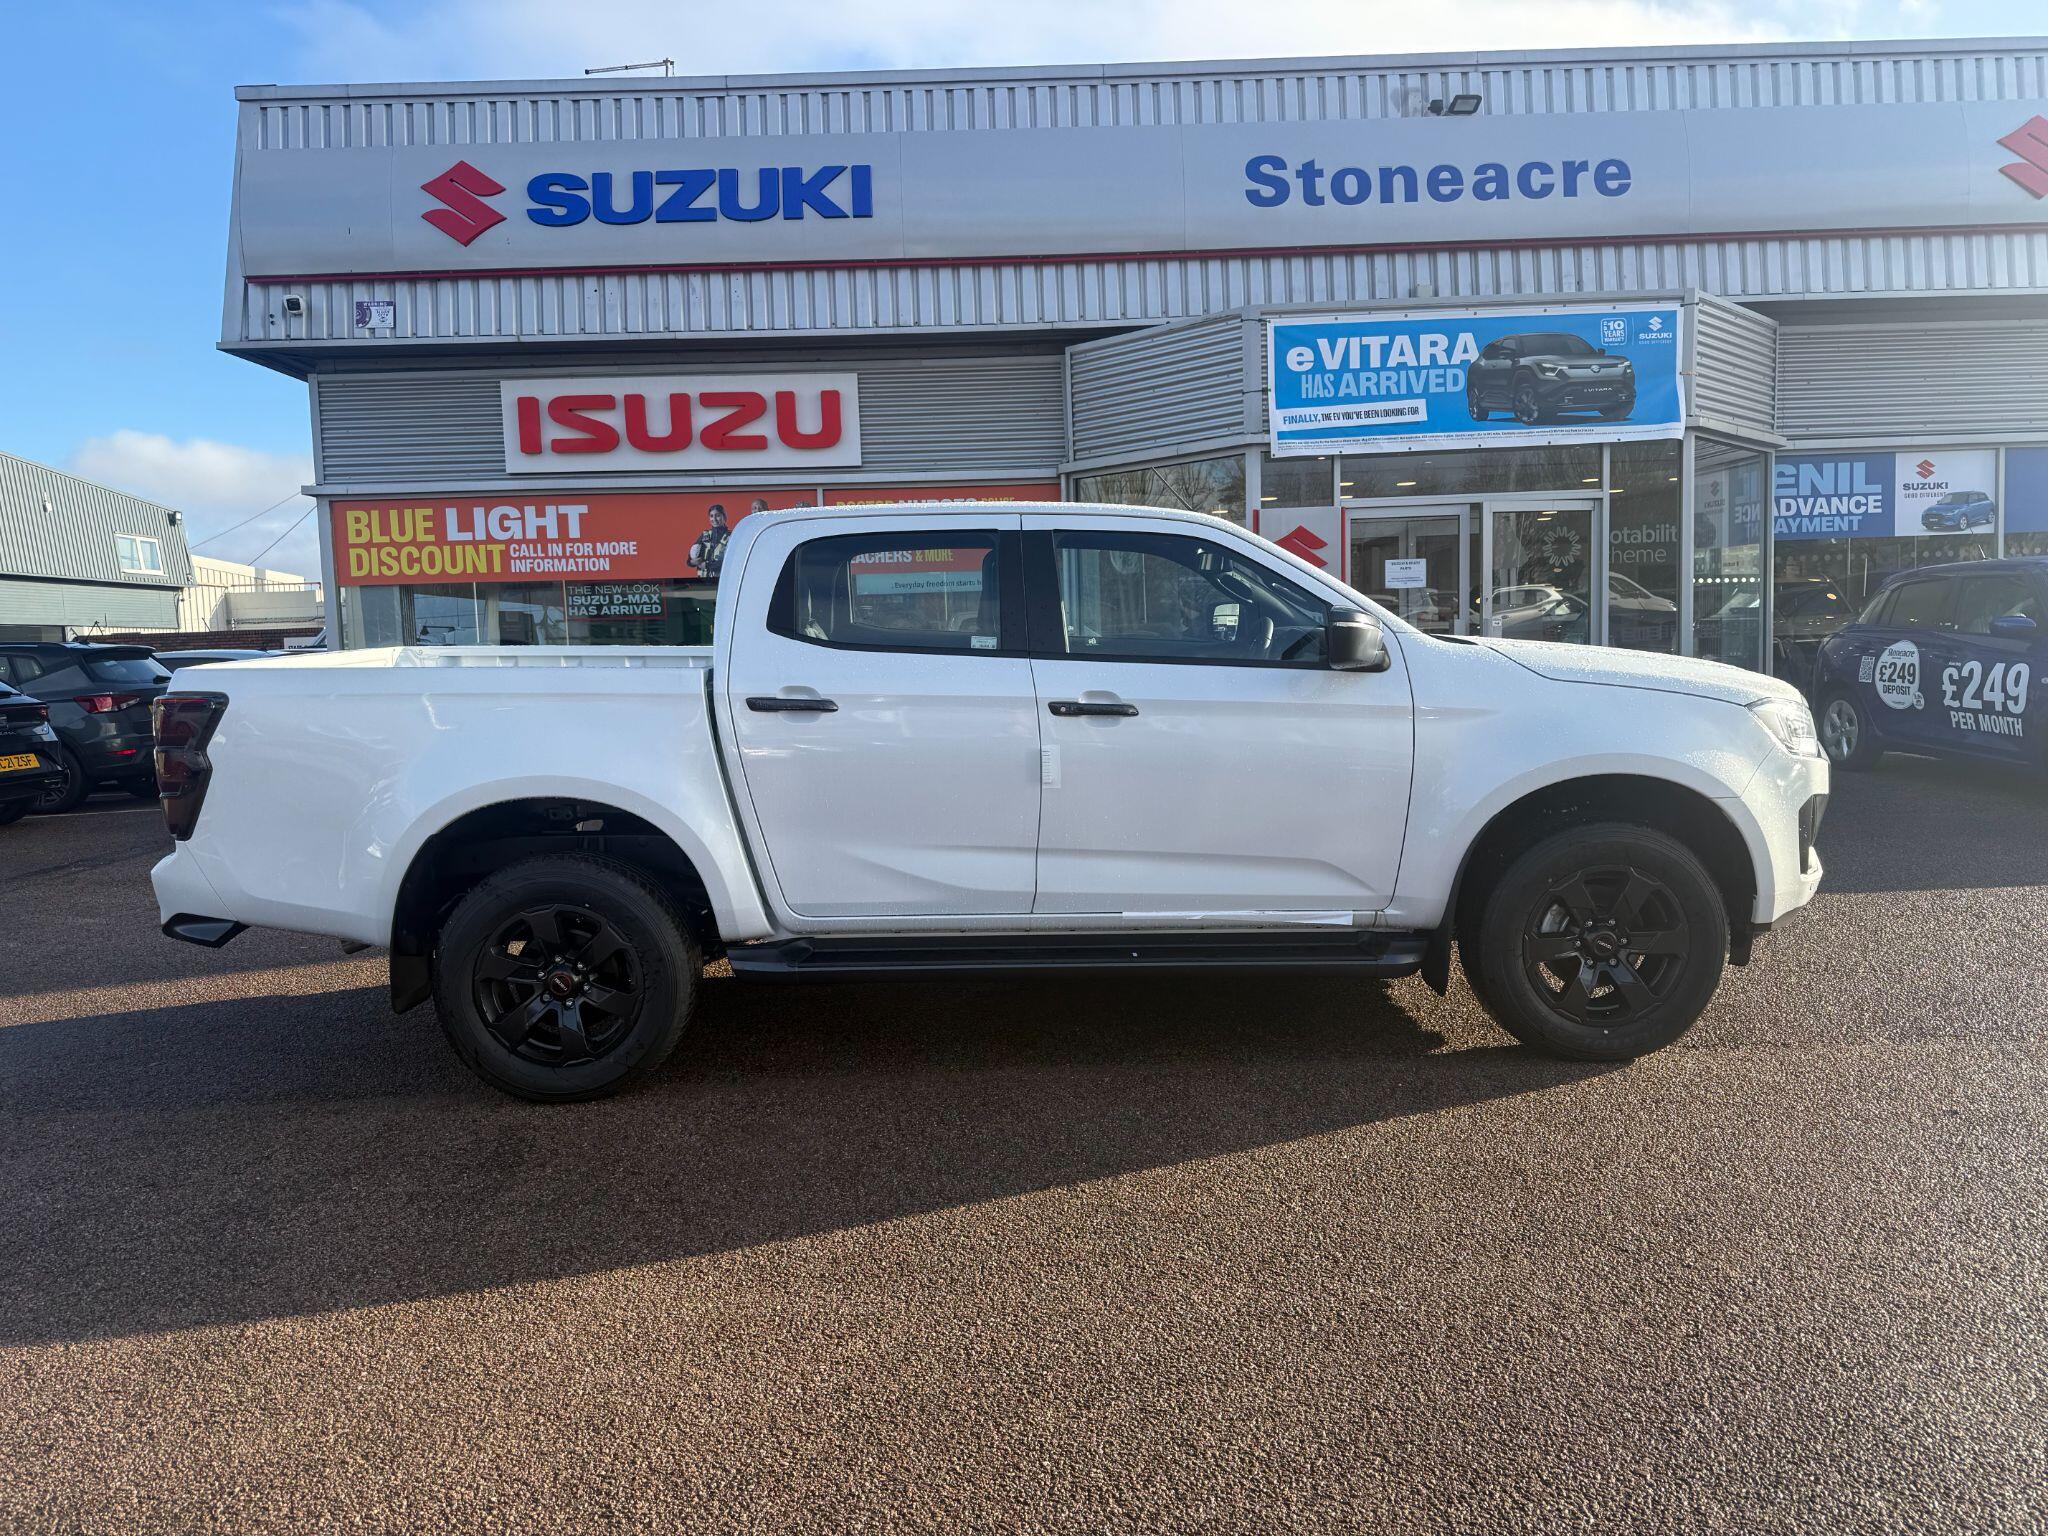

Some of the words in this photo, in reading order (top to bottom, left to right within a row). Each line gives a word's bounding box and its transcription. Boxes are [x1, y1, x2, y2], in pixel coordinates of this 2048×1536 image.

[1244, 154, 1632, 207] Stoneacre
[526, 164, 873, 227] SUZUKI
[1639, 332, 1673, 340] SUZUKI
[1301, 373, 1335, 399] HAS
[1338, 368, 1466, 398] ARRIVED
[517, 389, 841, 455] ISUZU
[1283, 413, 1321, 425] FINALLY,
[1321, 412, 1333, 422] THE
[1333, 412, 1341, 421] EV
[1341, 410, 1364, 421] YOU'VE
[1364, 409, 1380, 419] BEEN
[1380, 407, 1407, 418] LOOKING
[1407, 406, 1420, 416] FOR
[1902, 481, 1949, 491] SUZUKI
[346, 508, 435, 544] BLUE
[445, 504, 588, 541] LIGHT
[1610, 523, 1678, 544] otabilit
[1774, 516, 1862, 534] AYMENT
[510, 543, 545, 558] CALL
[547, 543, 563, 557] IN
[566, 542, 593, 556] FOR
[596, 541, 638, 556] MORE
[851, 550, 913, 564] ACHERS
[915, 550, 924, 562] &
[1611, 545, 1667, 564] heme
[349, 544, 505, 577] DISCOUNT
[511, 557, 610, 573] INFORMATION
[567, 585, 592, 595] THE
[595, 584, 660, 595] NEW-LOOK
[894, 581, 924, 590] Everyday
[926, 579, 955, 588] freedom
[568, 594, 609, 606] ISUZU
[613, 593, 660, 605] D-MAX
[568, 605, 597, 616] HAS
[600, 604, 662, 616] ARRIVED
[1878, 661, 1917, 685] £249
[1882, 684, 1911, 696] DEPOSIT
[1941, 660, 2030, 714] £249
[1950, 710, 1977, 731] PER
[1978, 713, 2023, 737] MONTH
